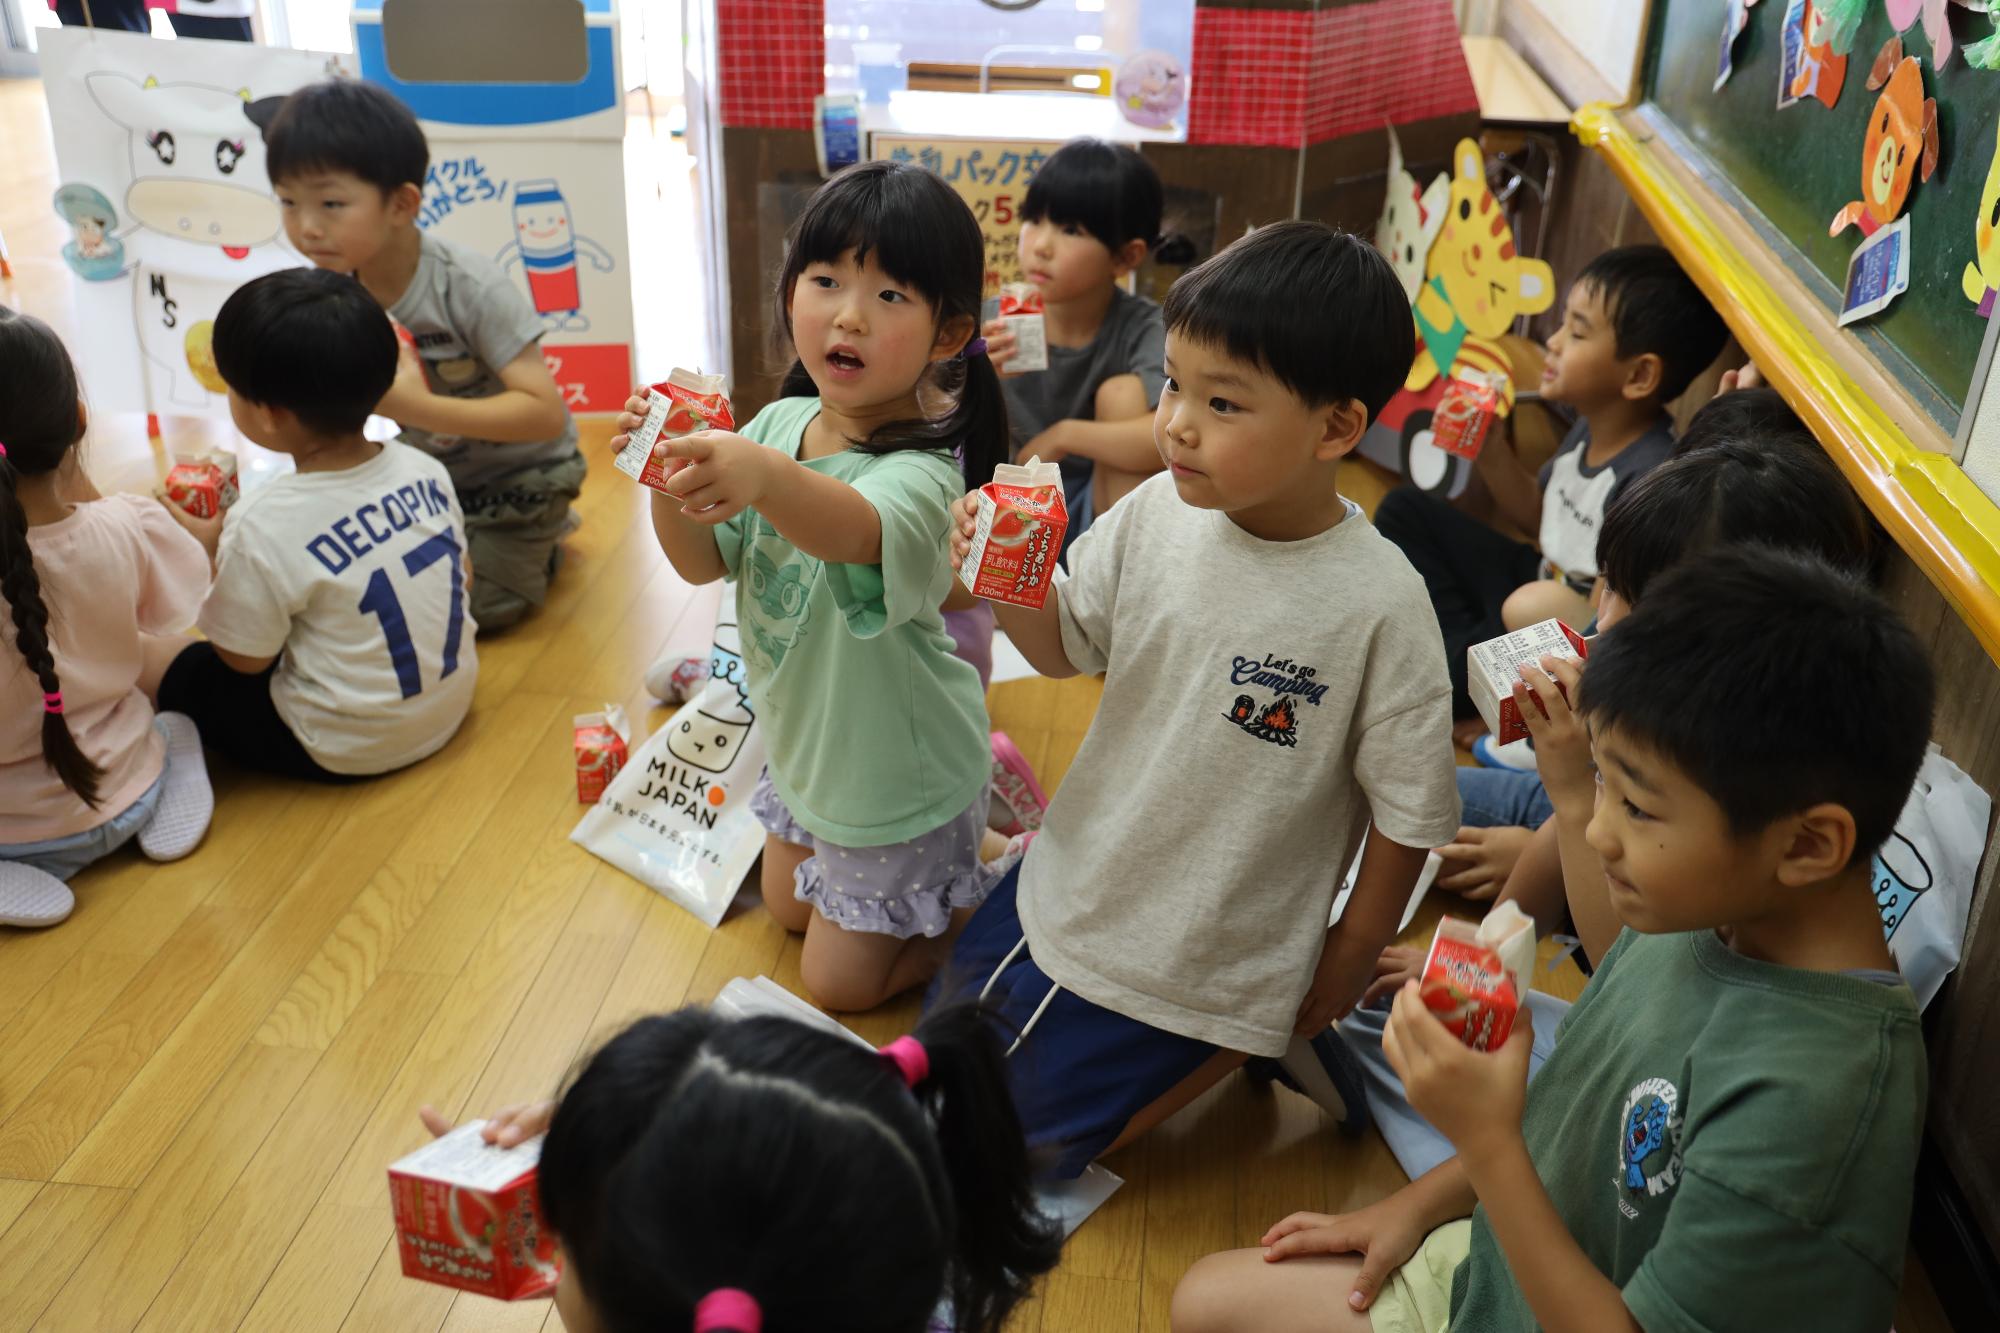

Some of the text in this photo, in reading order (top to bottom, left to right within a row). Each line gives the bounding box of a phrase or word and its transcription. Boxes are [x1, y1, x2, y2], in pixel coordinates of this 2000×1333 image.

[984, 552, 1020, 572] 乳飲料
[1013, 529, 1040, 594] いちごミルク
[1028, 525, 1053, 588] とちあいか
[358, 525, 464, 699] 17
[1230, 655, 1330, 706] Camping
[1262, 653, 1317, 680] Let's go
[647, 756, 710, 798] MILK
[638, 781, 718, 830] JAPAN
